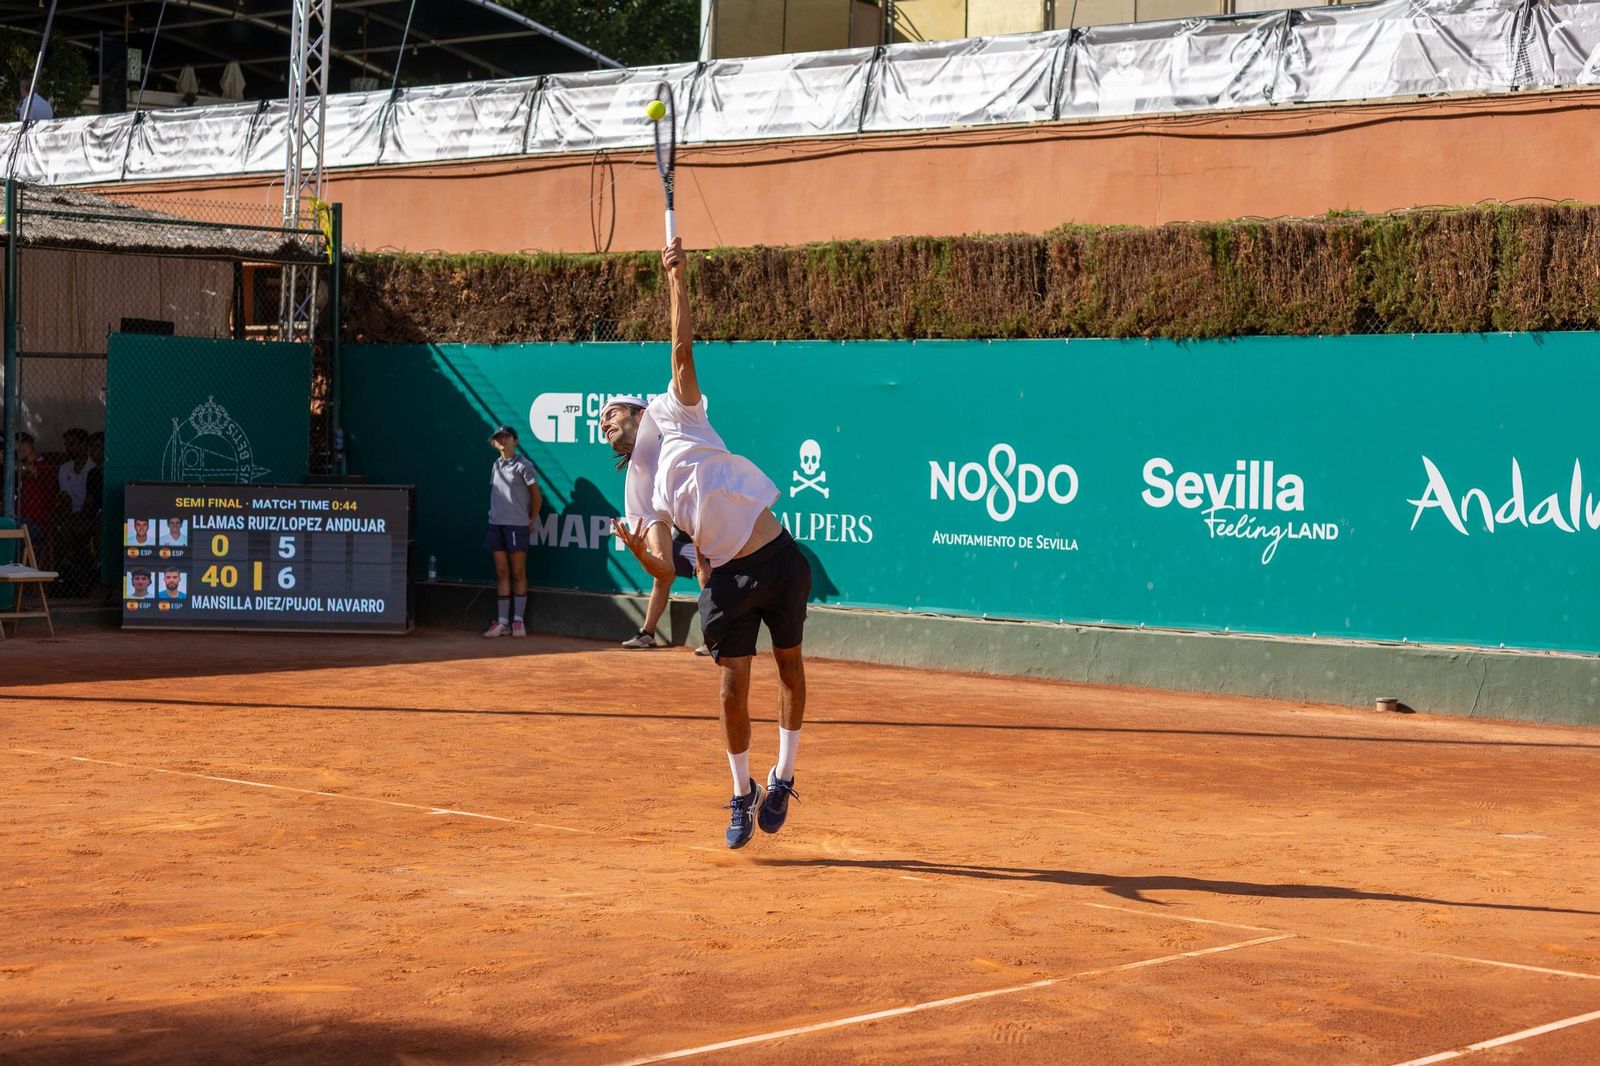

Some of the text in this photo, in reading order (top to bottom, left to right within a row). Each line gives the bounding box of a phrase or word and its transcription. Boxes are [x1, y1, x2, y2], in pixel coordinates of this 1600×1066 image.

[563, 405, 580, 413] ATP
[226, 423, 250, 460] BETIS
[1141, 457, 1305, 511] Sevilla
[175, 498, 358, 511] SEMI FINAL MATCH TIME 0:44
[192, 515, 386, 533] LLAMAS RUIZ/LOPEZ ANDUJAR
[770, 511, 873, 544] ALPERS
[211, 534, 229, 557] 0
[278, 536, 296, 559] 5
[201, 565, 238, 588] 40
[278, 566, 296, 589] 6
[191, 596, 385, 613] MANSILLA DIEZ/PUJOL NAVARRO
